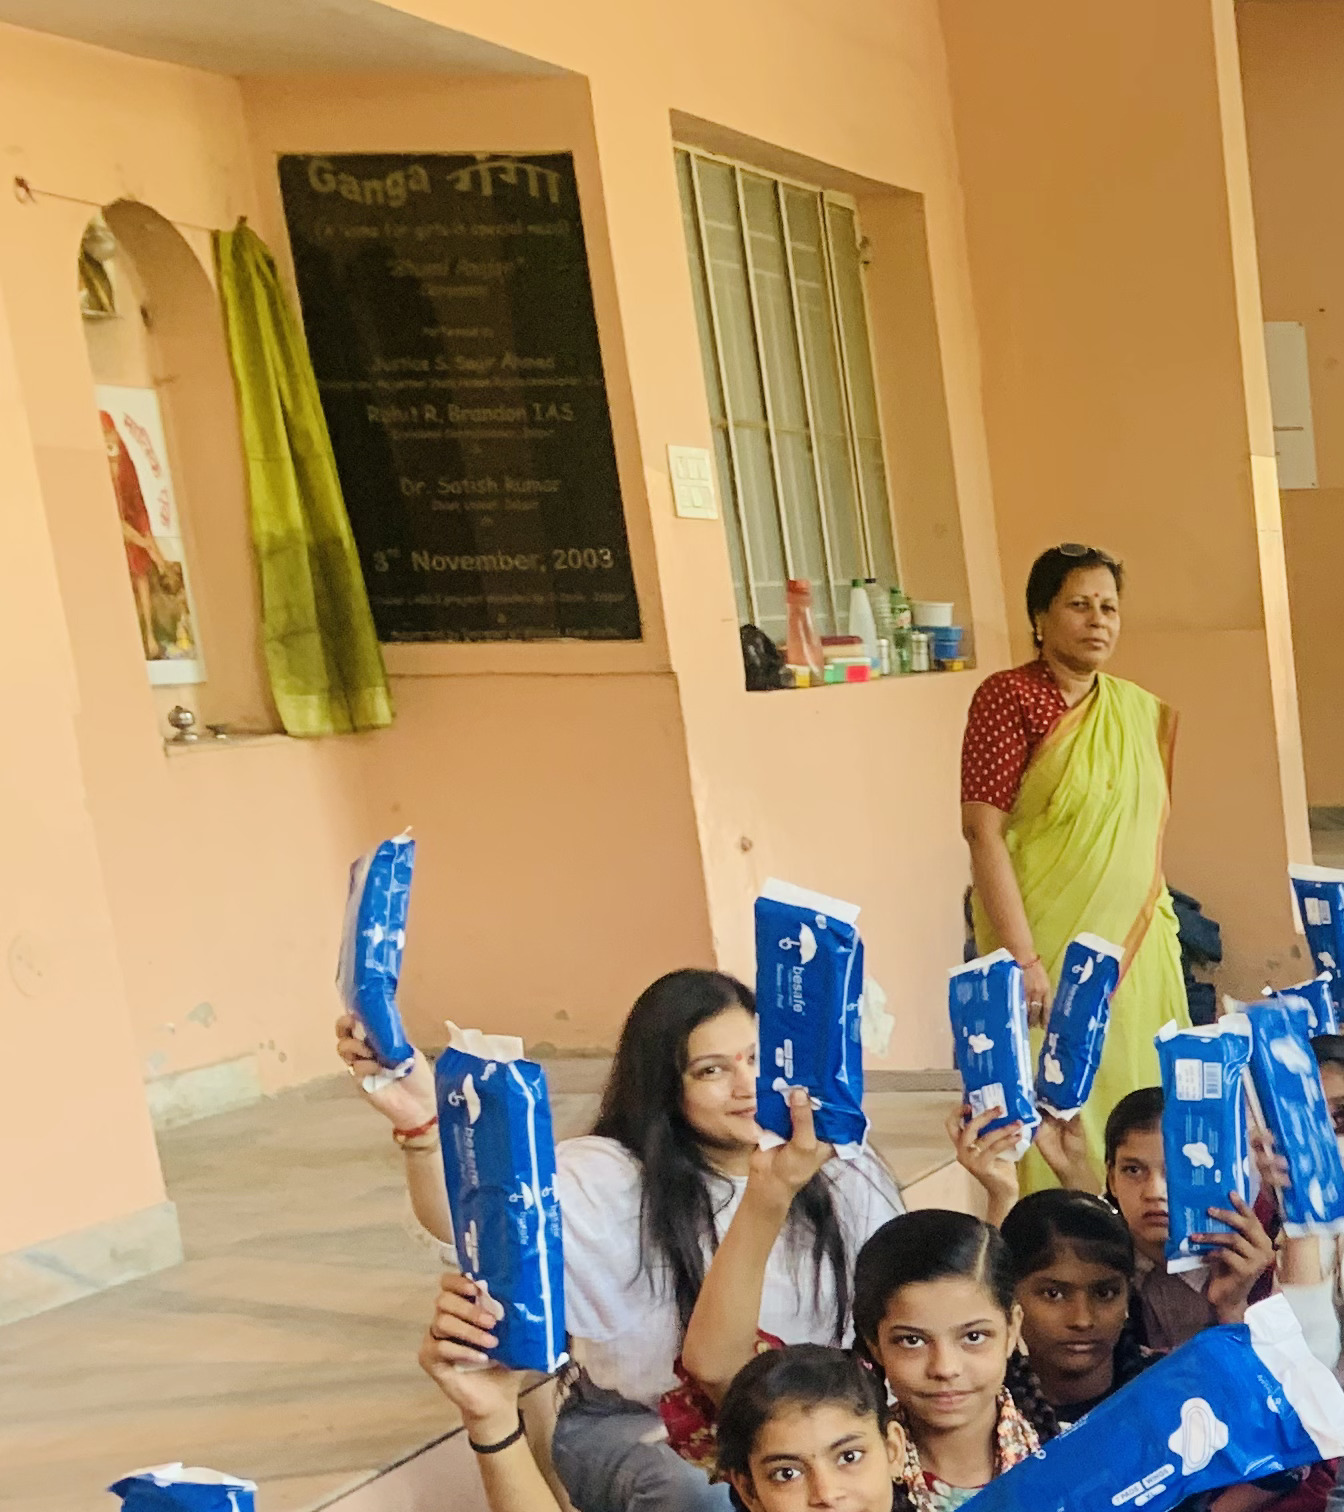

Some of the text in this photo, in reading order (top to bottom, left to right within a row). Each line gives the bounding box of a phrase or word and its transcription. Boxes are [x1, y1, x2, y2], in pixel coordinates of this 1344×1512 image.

[307, 153, 561, 207] Ganga गंगा
[411, 550, 547, 573] November,
[553, 549, 615, 570] 2003
[792, 965, 804, 1013] besafe
